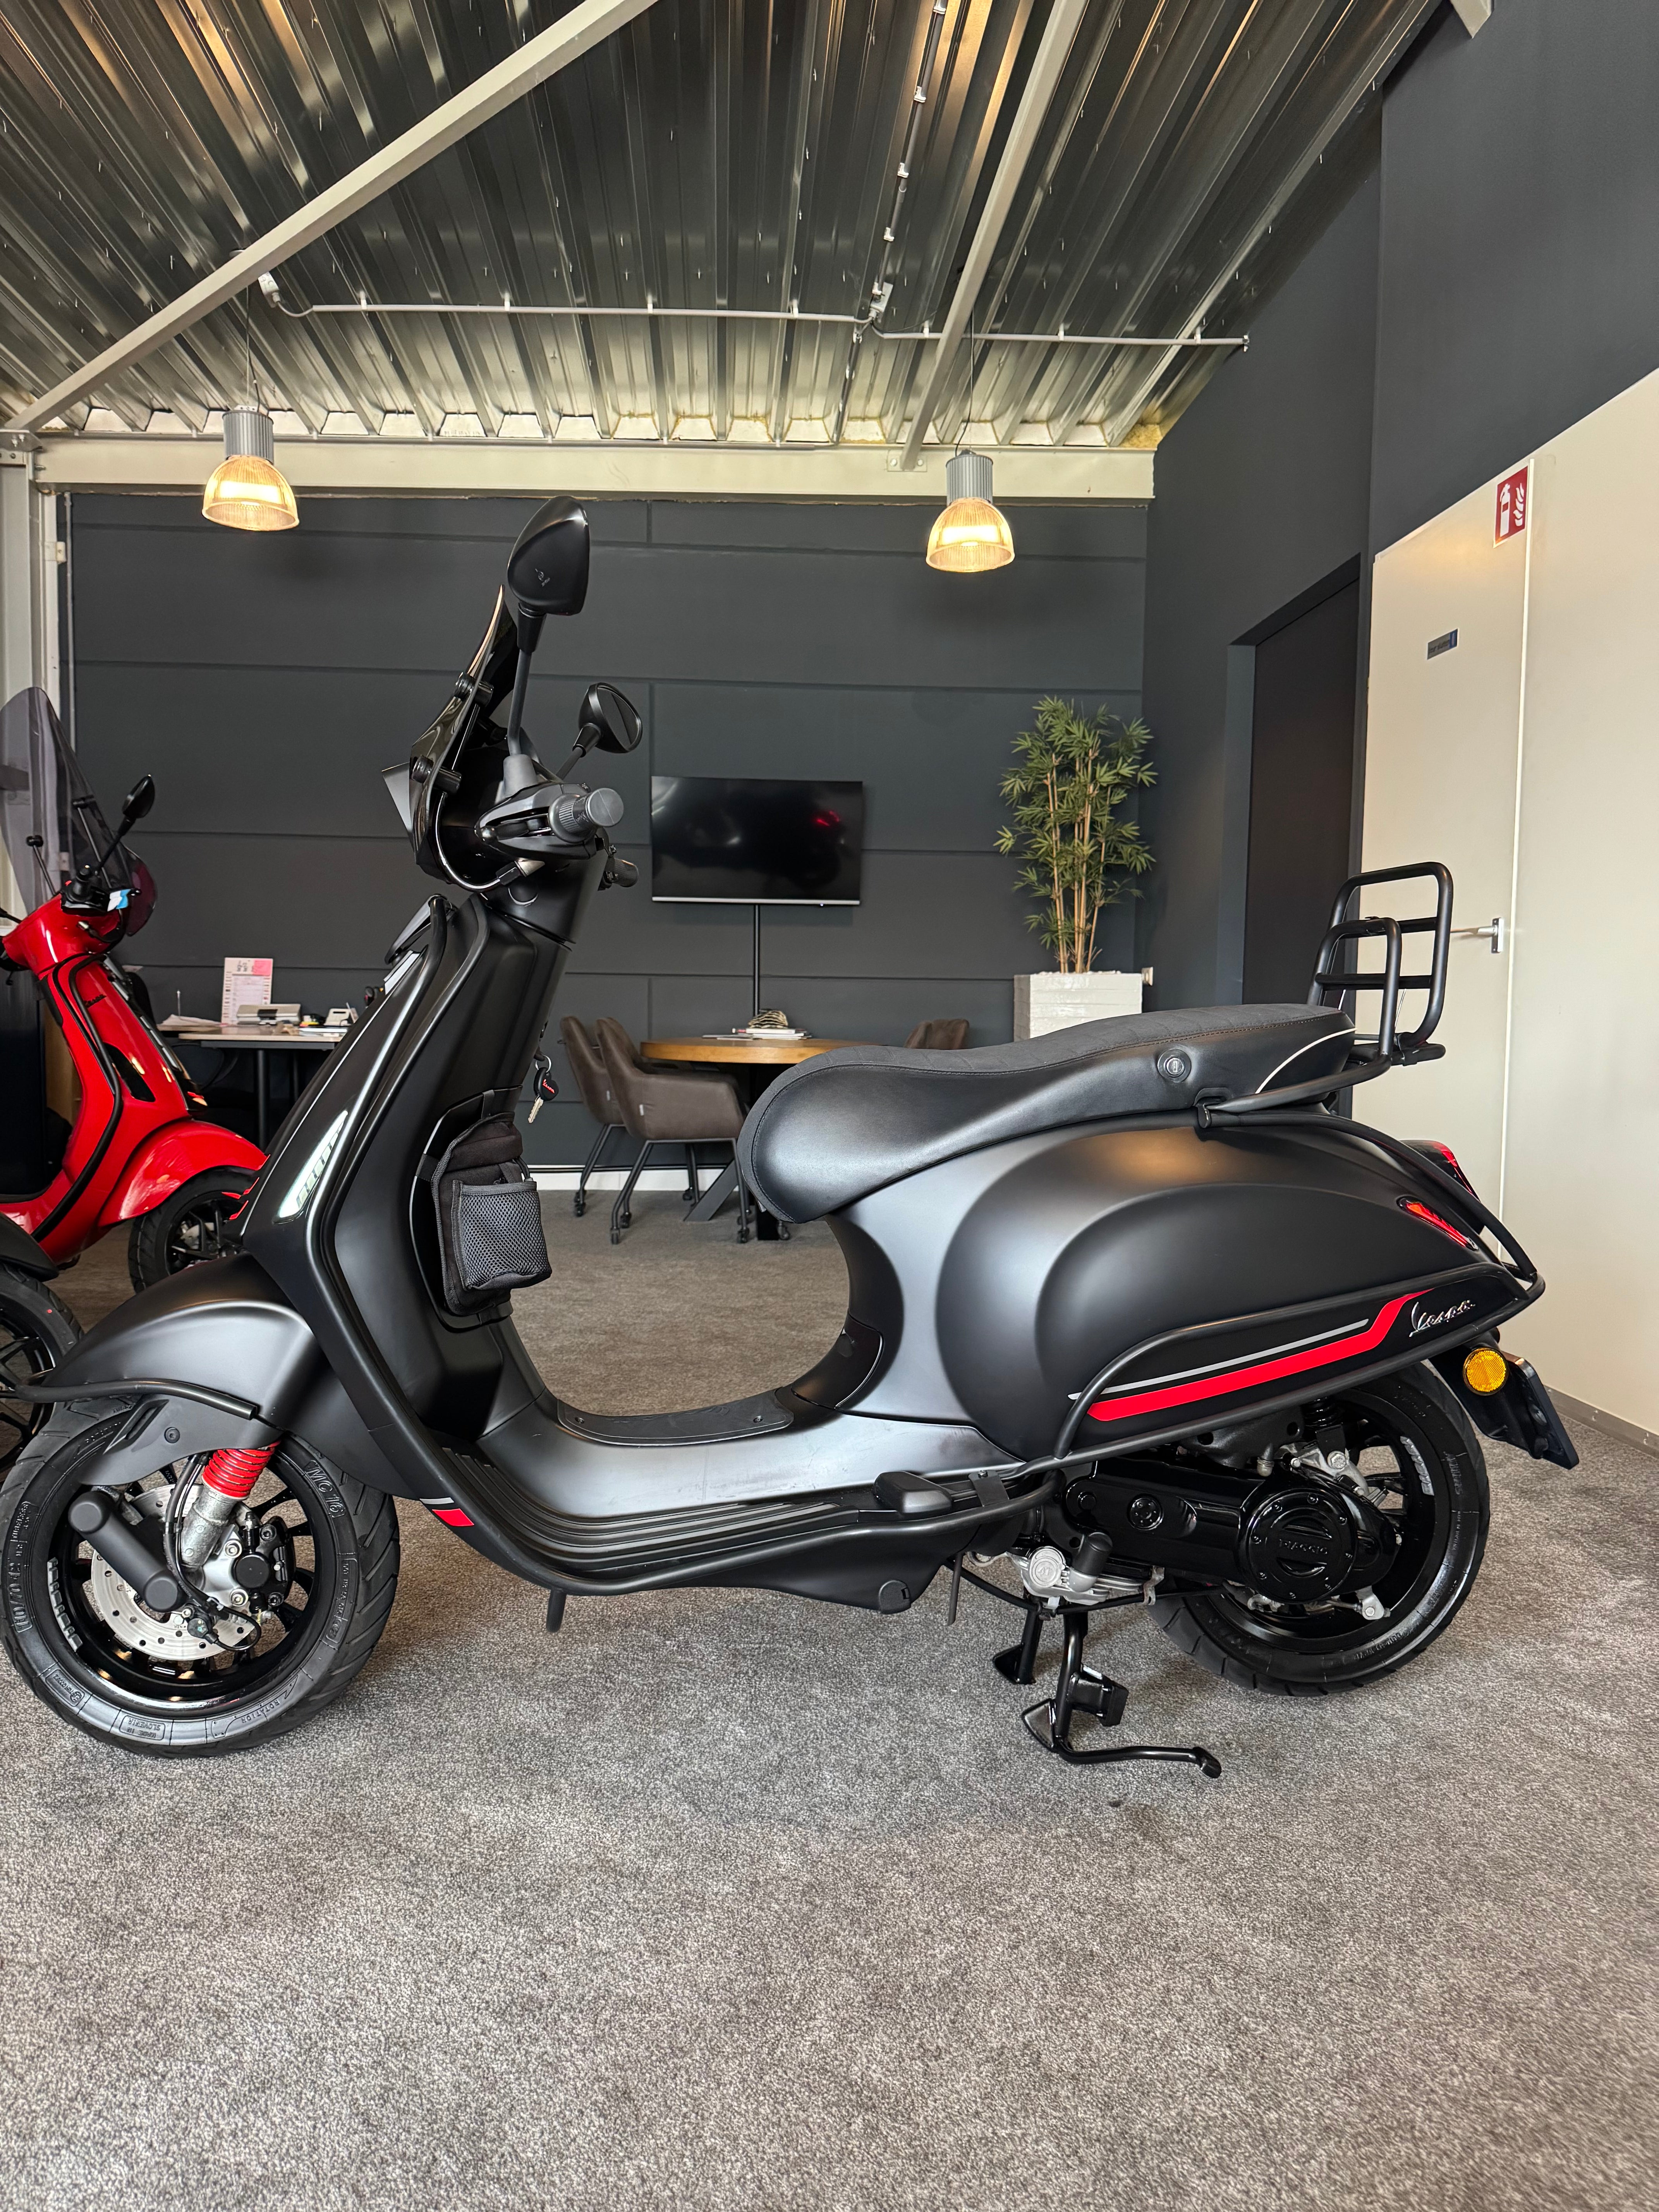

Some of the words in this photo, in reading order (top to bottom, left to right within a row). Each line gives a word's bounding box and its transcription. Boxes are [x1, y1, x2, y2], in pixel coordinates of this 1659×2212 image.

[1409, 1300, 1476, 1337] Vespa
[306, 1466, 334, 1493] MC
[325, 1494, 346, 1513] 16
[241, 1699, 280, 1723] ROTATION
